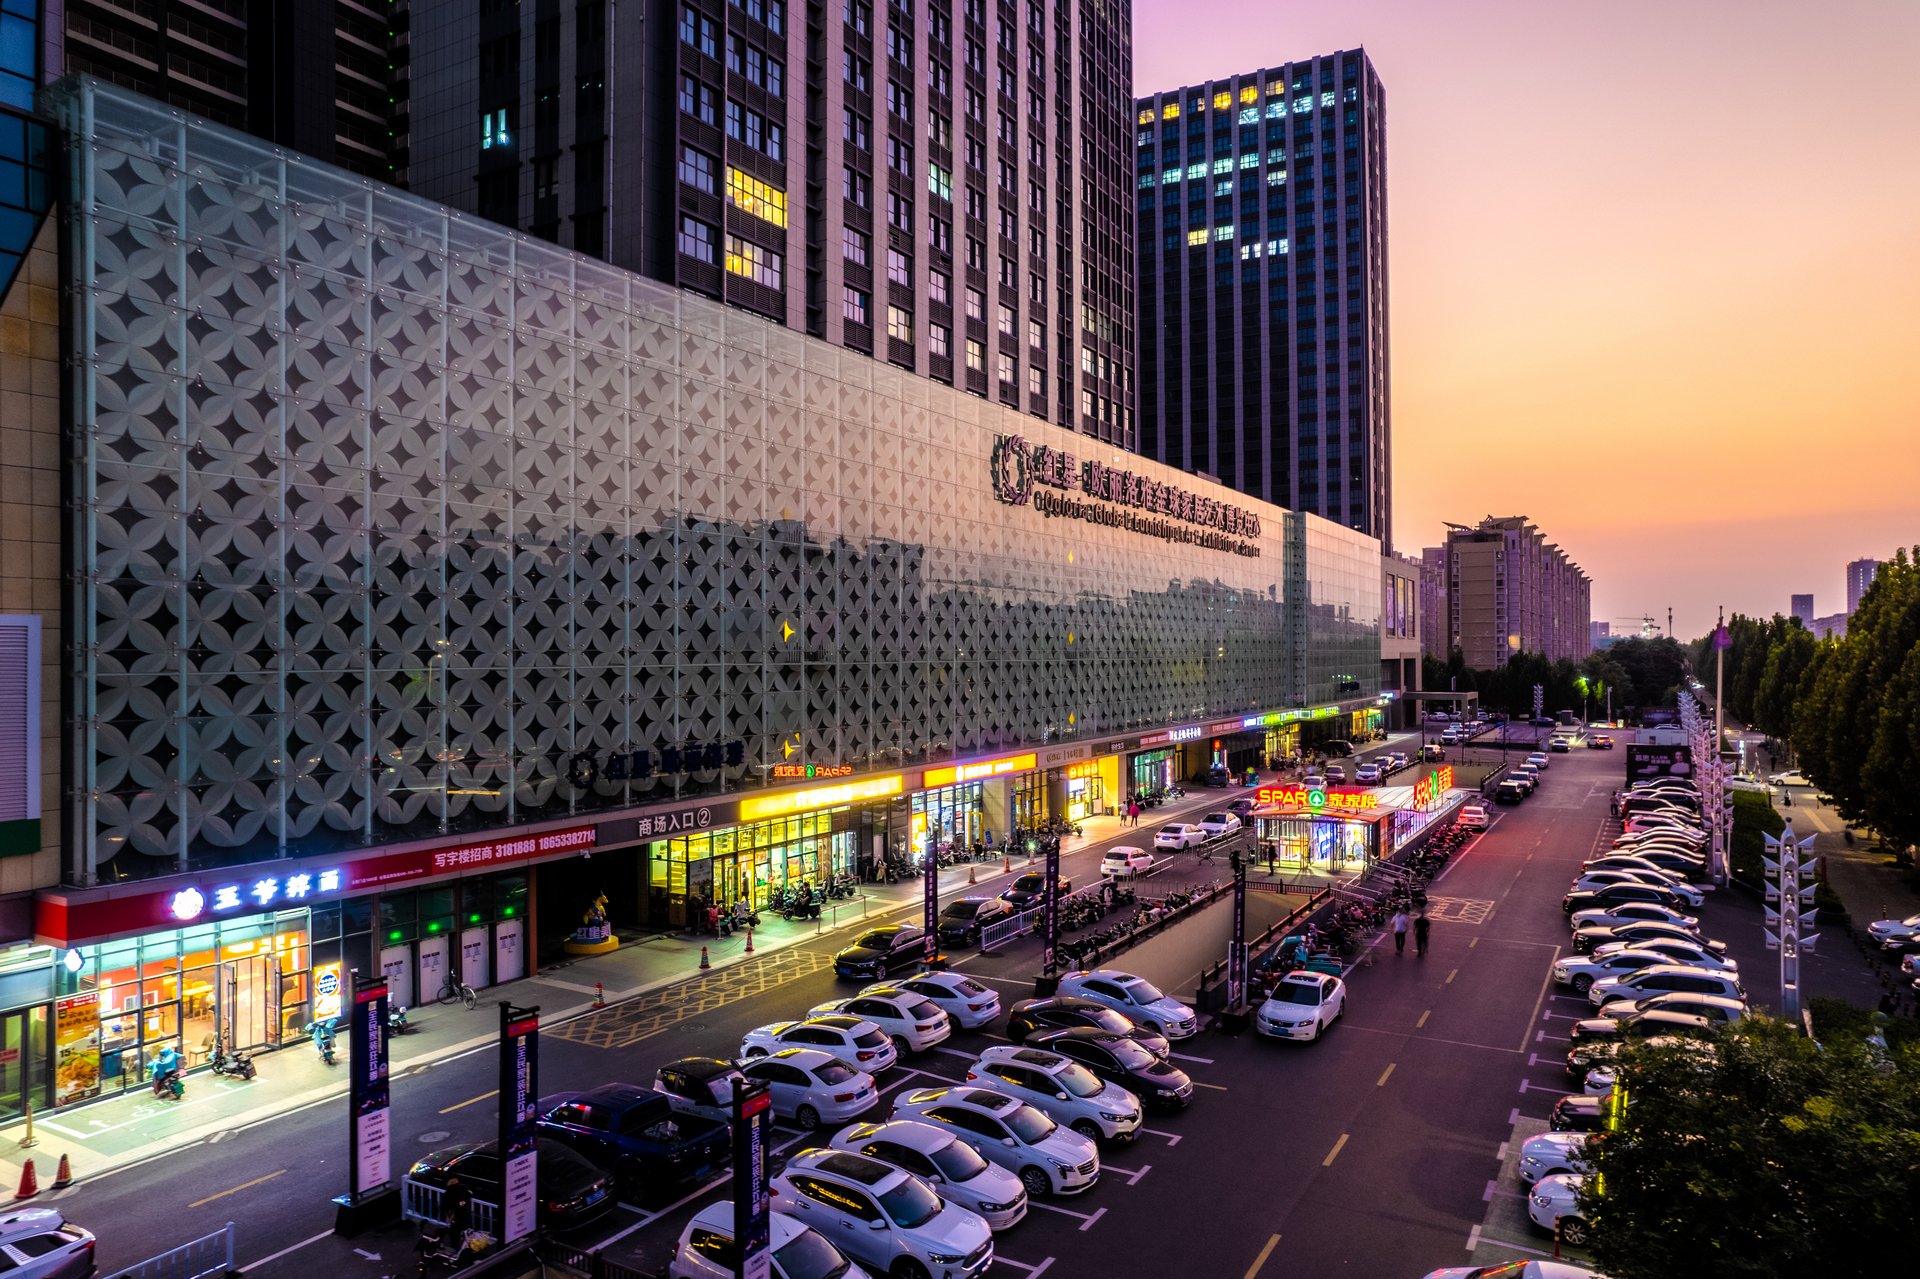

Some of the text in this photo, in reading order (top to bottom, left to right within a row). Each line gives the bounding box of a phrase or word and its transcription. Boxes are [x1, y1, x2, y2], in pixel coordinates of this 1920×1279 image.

[1095, 502, 1129, 530] Global
[1259, 789, 1378, 809] SPAR 家家悦
[434, 846, 493, 868] 写字楼招商
[495, 839, 536, 858] 3181888
